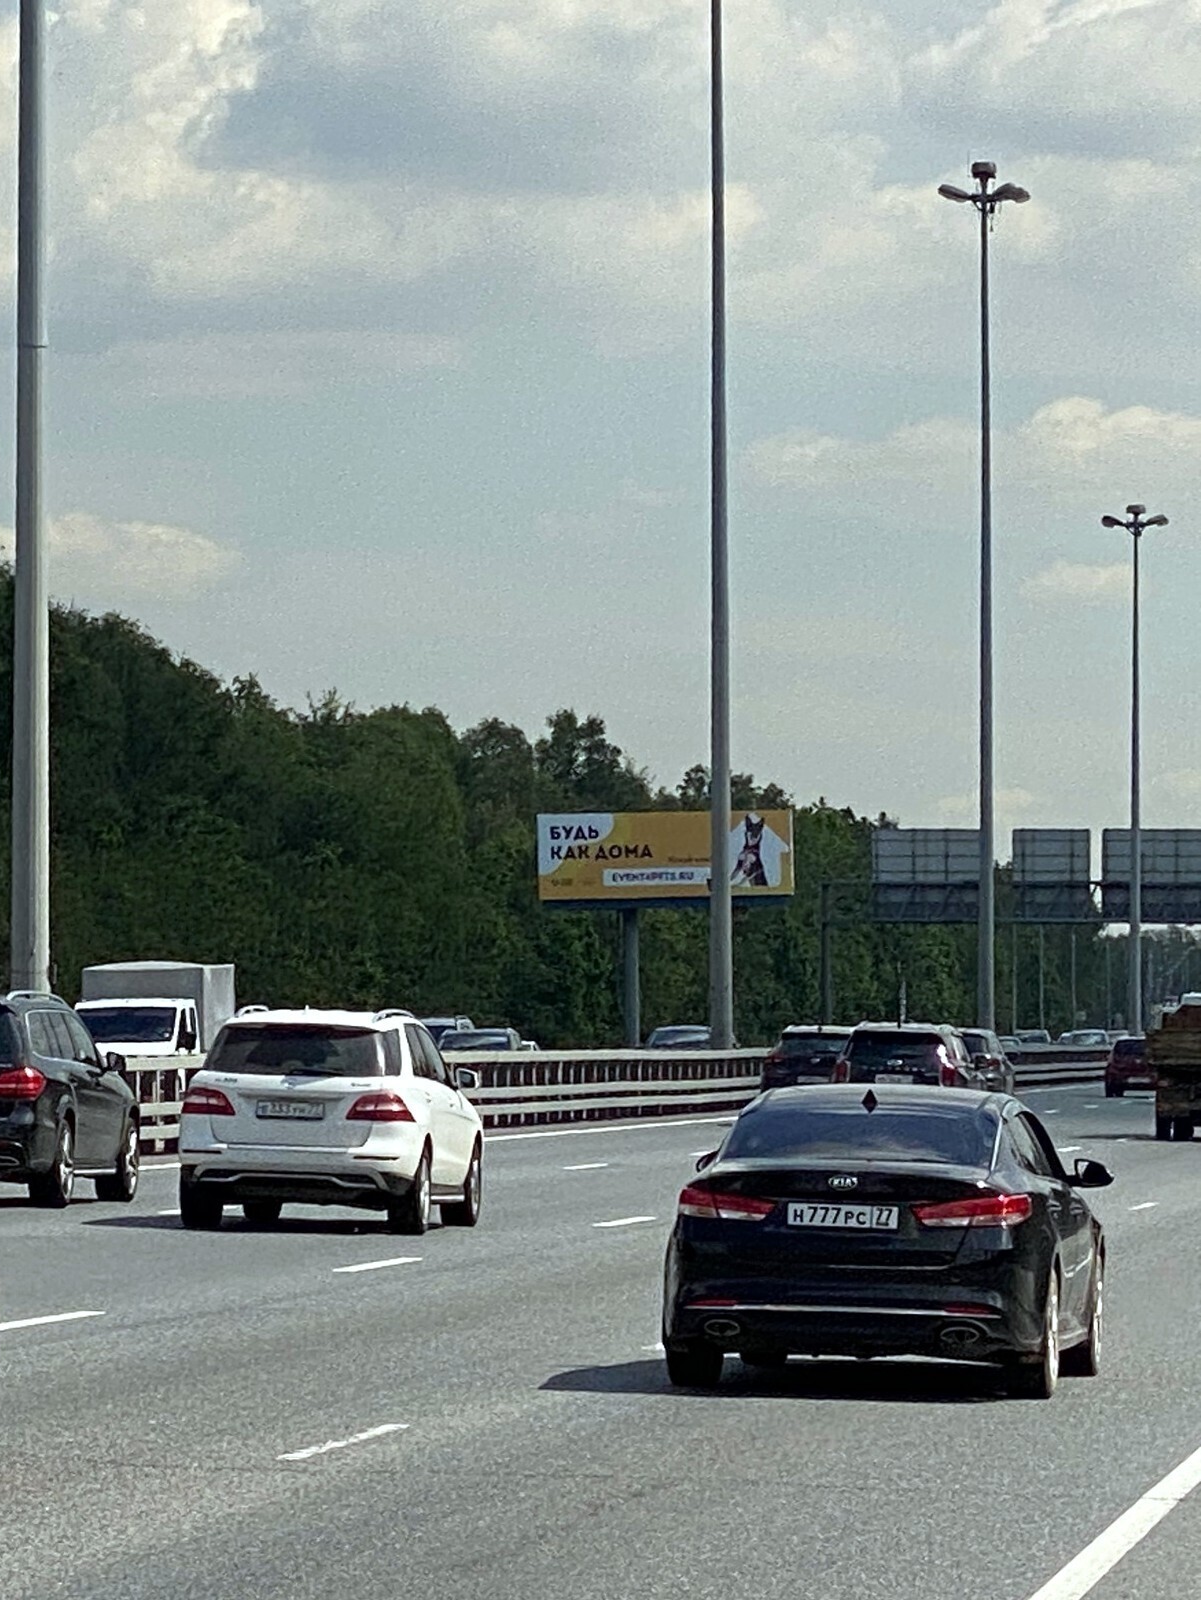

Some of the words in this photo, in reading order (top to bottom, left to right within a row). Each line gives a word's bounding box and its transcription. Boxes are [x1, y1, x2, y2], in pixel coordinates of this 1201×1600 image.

[550, 825, 599, 841] БУДЬ
[550, 844, 590, 860] КАК
[595, 844, 654, 861] ДОМА
[832, 1177, 853, 1188] KIA
